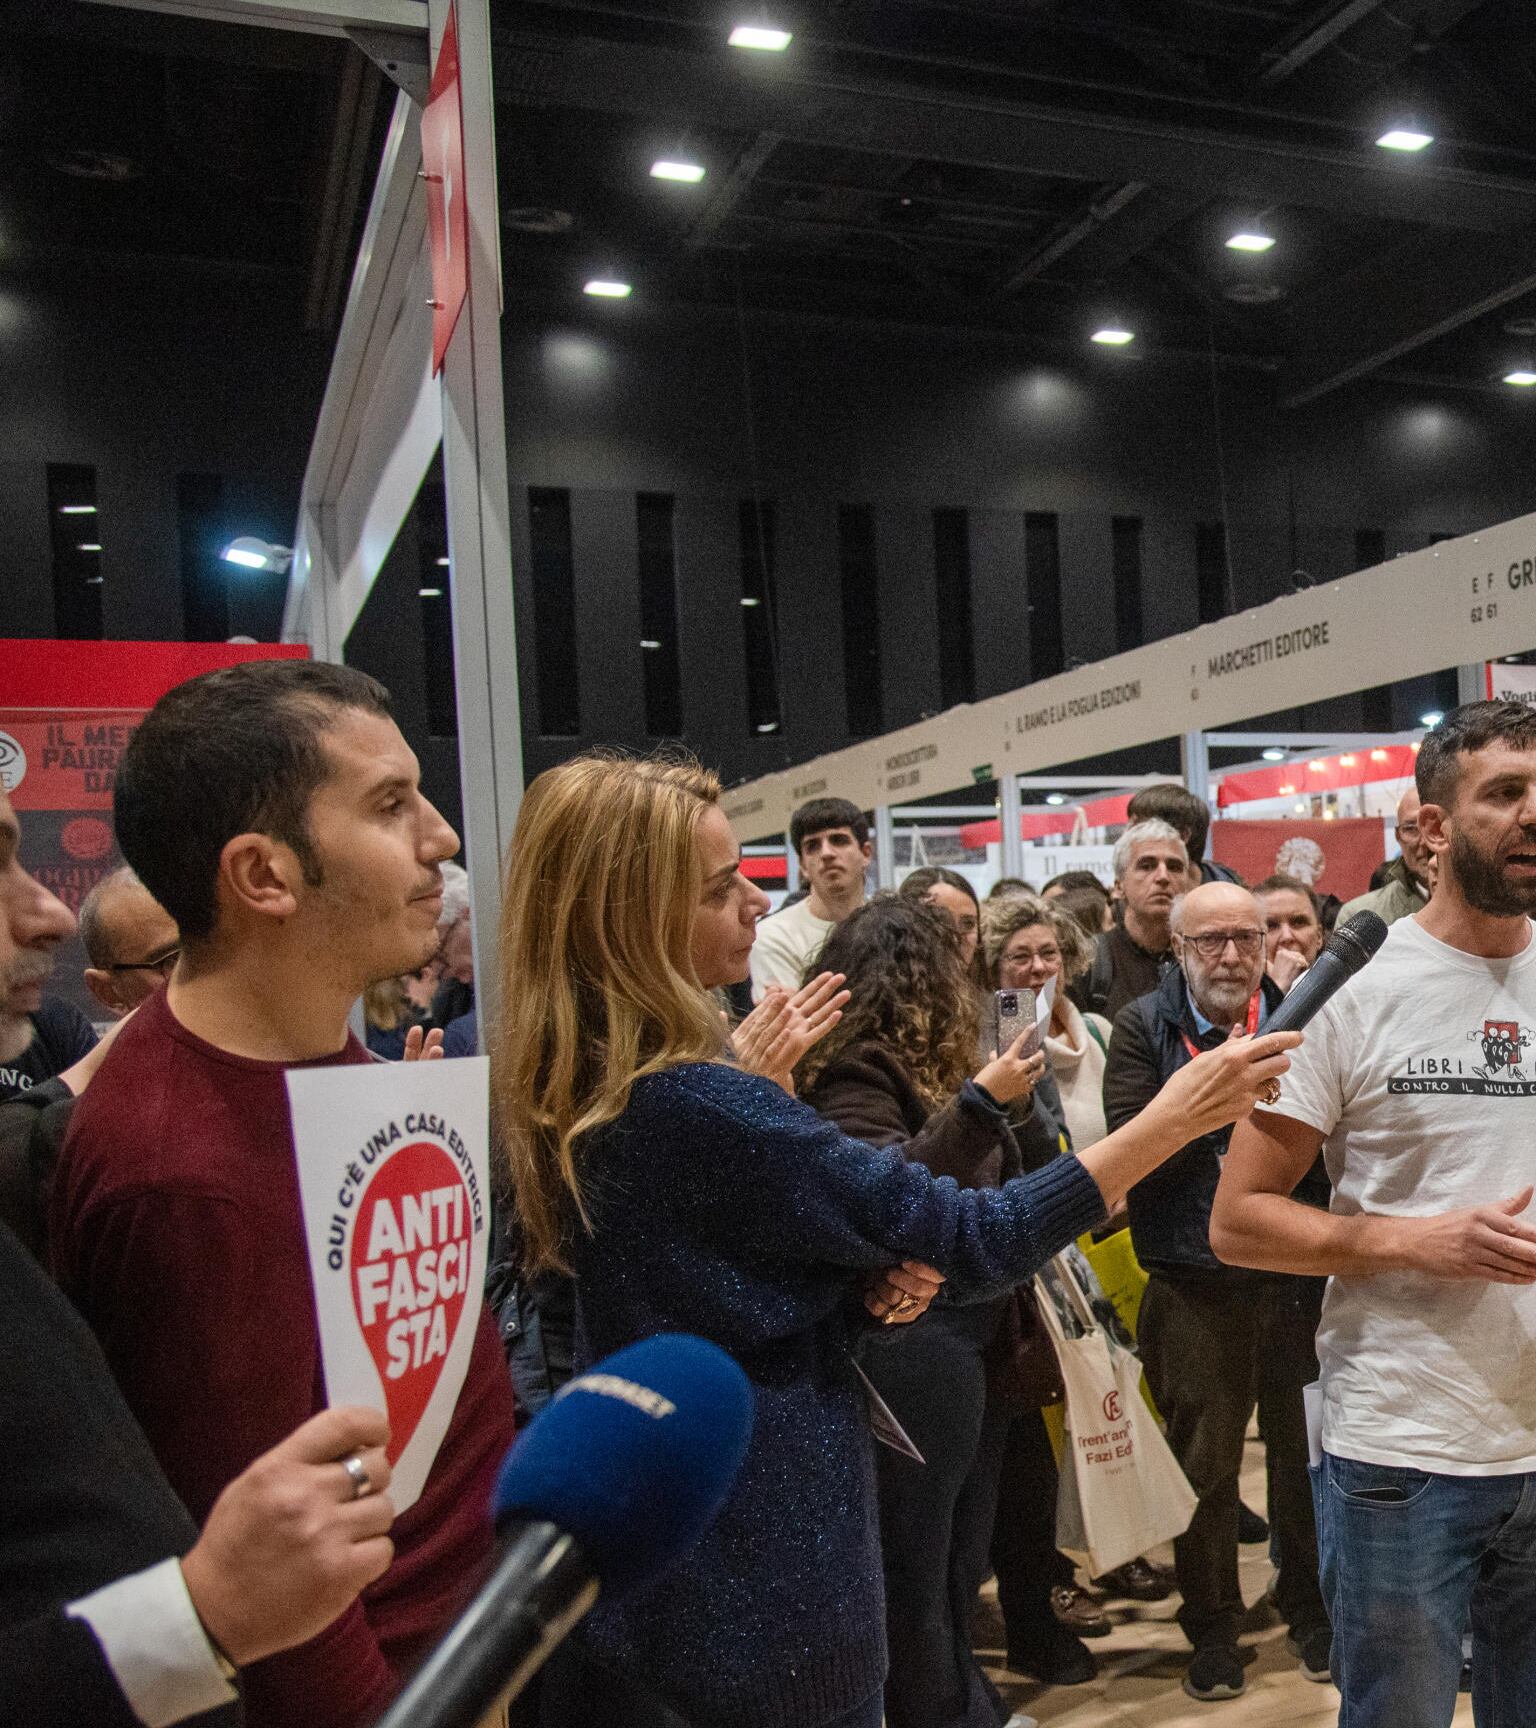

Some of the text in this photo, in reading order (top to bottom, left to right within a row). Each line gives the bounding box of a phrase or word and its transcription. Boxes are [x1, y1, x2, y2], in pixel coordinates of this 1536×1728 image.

[1472, 572, 1494, 594] E F
[1470, 603, 1498, 624] 62 61
[1208, 620, 1330, 679] MARCHETTI EDITORE
[1407, 1057, 1462, 1075] LIBRI
[1391, 1081, 1450, 1092] CONTRO
[1461, 1082, 1474, 1093] IL
[1485, 1084, 1524, 1095] NULLA
[328, 1214, 347, 1271] QUI
[360, 1121, 401, 1164] UNA
[405, 1112, 445, 1137] CASA
[448, 1128, 484, 1234] EDITRICE
[366, 1184, 465, 1261] ANTI
[357, 1239, 469, 1327] FASCI
[385, 1304, 448, 1380] STA
[1086, 1451, 1113, 1465] Fazi
